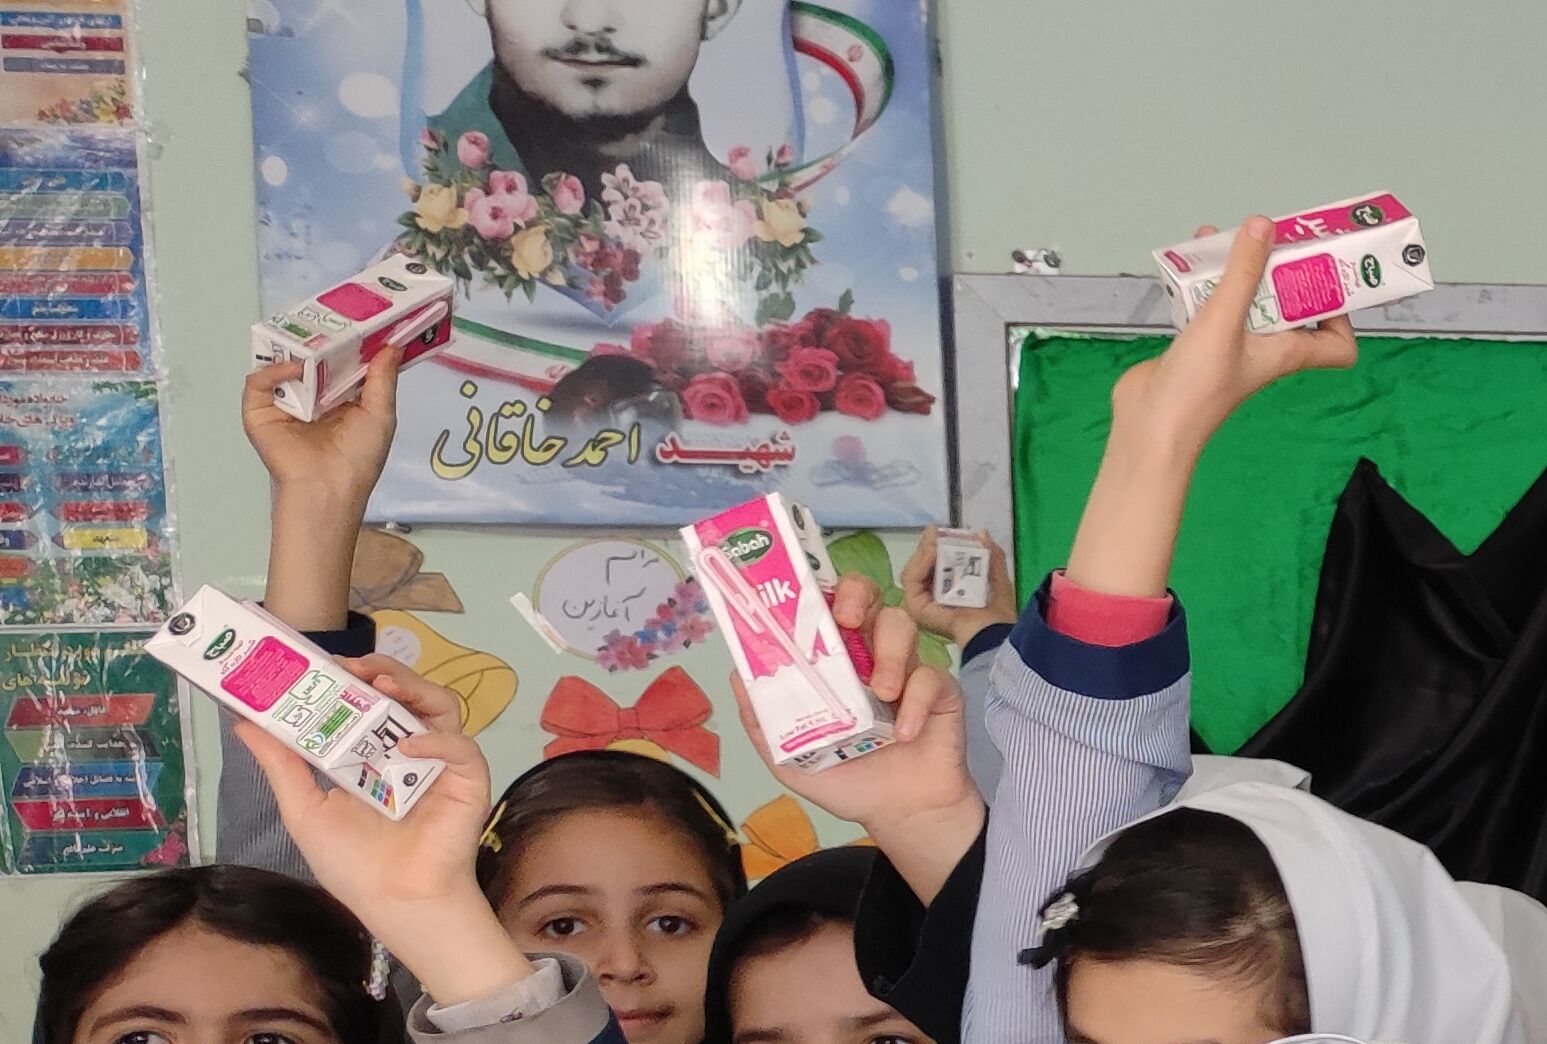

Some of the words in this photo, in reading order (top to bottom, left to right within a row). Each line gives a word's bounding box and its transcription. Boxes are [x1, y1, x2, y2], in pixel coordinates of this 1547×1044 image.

[430, 380, 566, 481] خاقانی
[563, 422, 642, 469] احمد
[656, 431, 797, 473] شهید
[605, 549, 661, 586] مراسم
